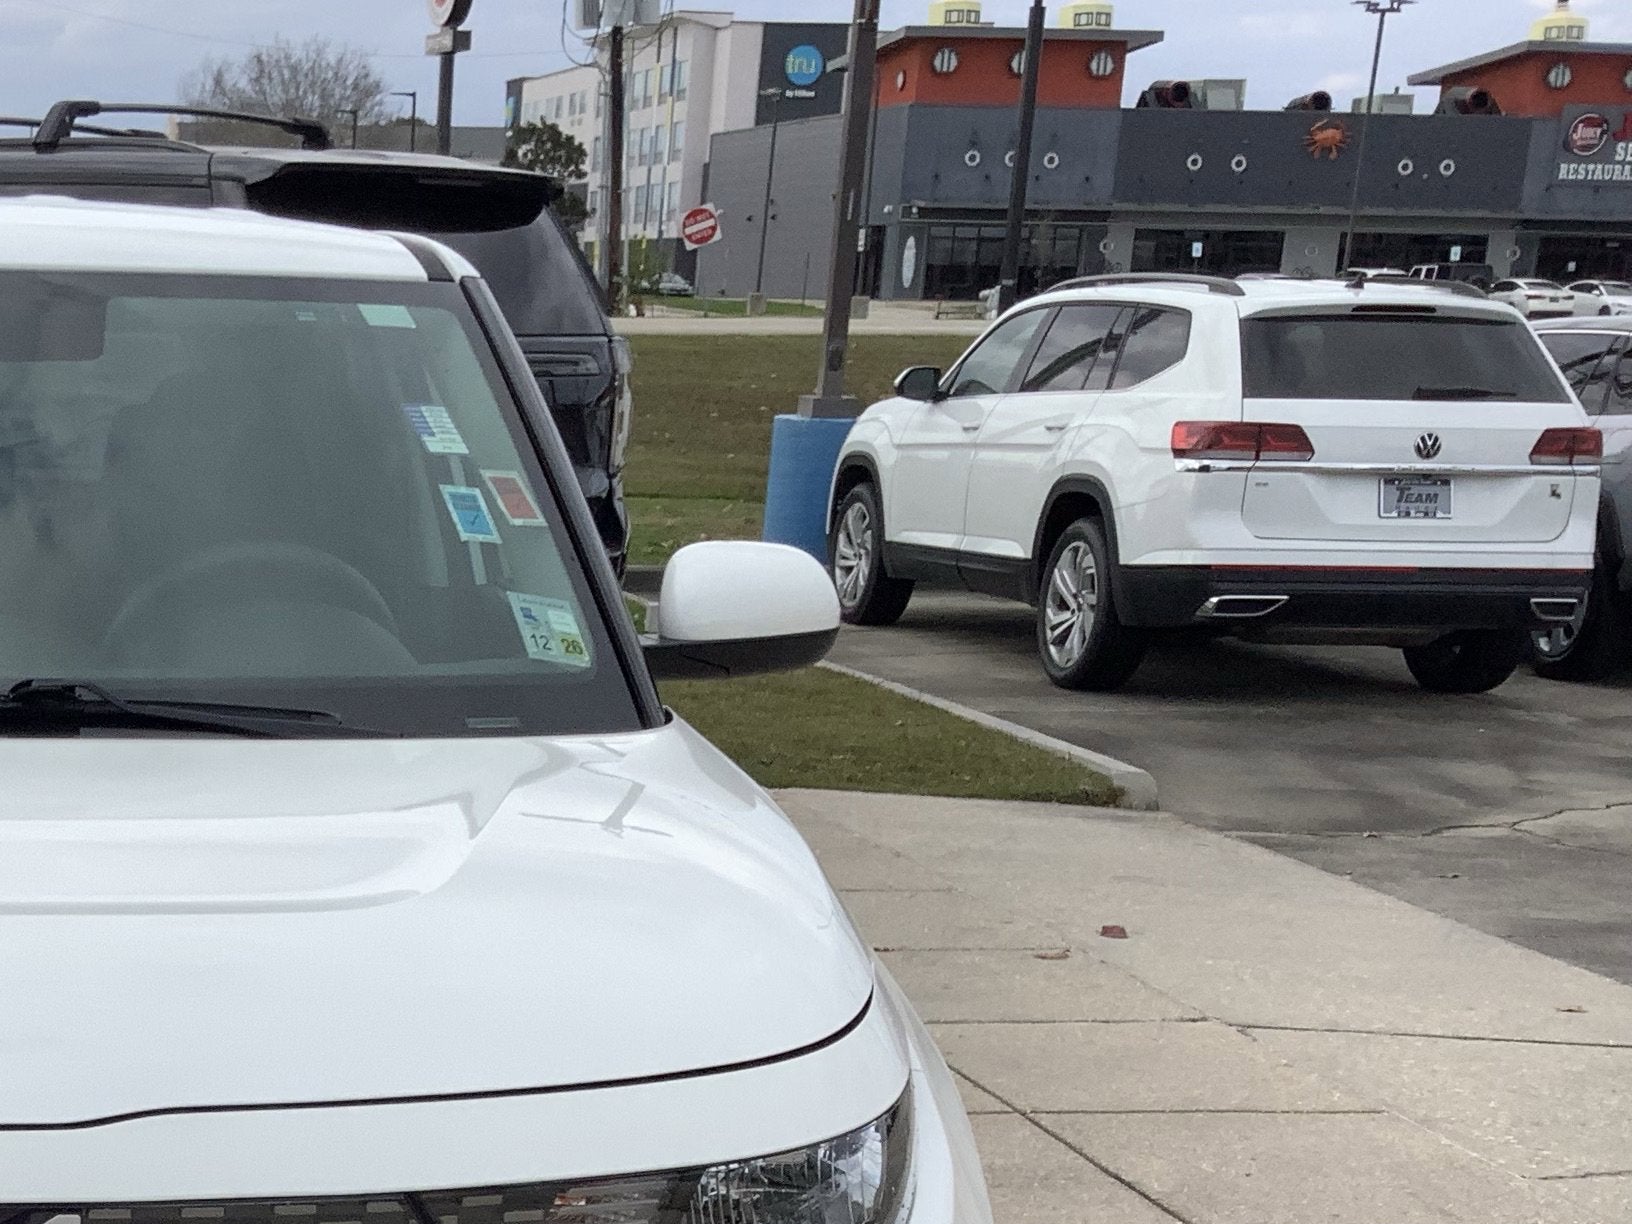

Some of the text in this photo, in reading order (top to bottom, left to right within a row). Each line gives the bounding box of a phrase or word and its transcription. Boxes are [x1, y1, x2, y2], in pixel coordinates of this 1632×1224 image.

[785, 54, 816, 74] tru
[529, 633, 584, 656] 12 26
